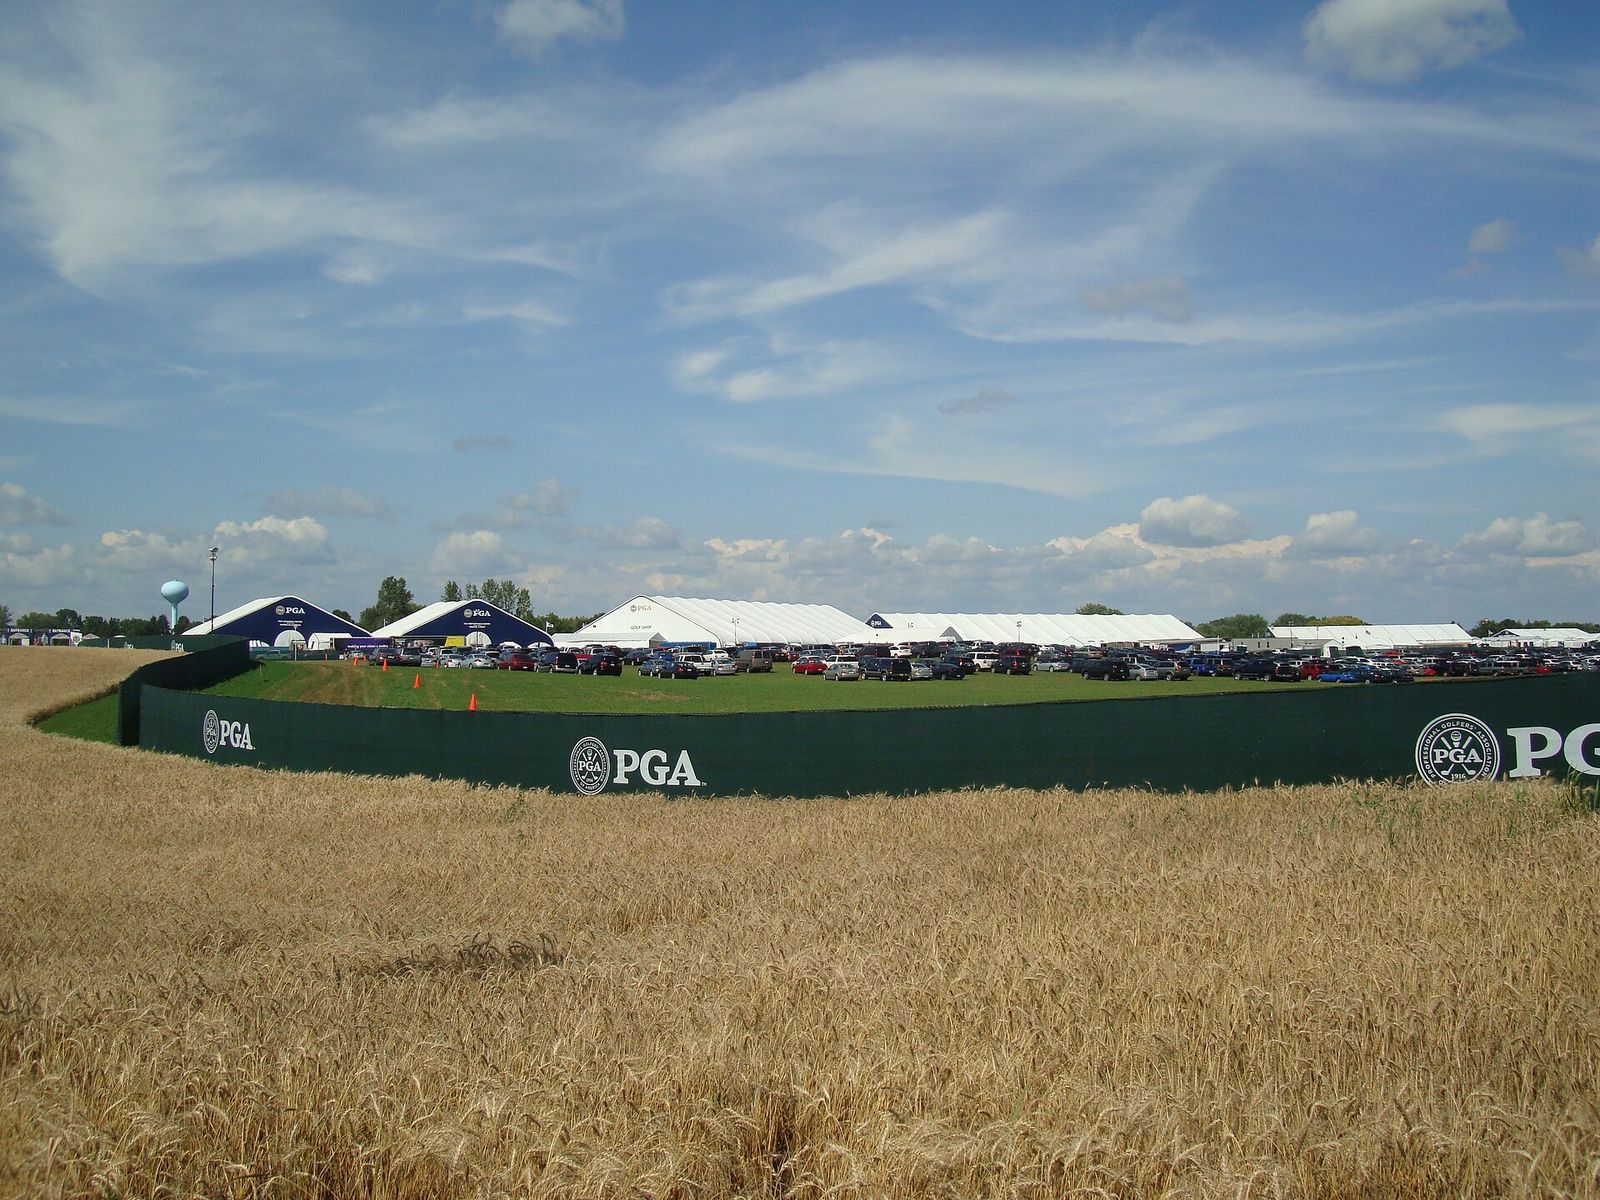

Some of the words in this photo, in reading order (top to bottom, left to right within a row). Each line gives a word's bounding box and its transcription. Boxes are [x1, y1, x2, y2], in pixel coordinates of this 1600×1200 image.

[219, 720, 253, 750] PGA
[578, 760, 602, 772] PGA
[613, 749, 701, 786] PGA
[1422, 728, 1441, 778] PROFESSIONAL
[1476, 731, 1493, 777] ASSOCIATION
[1433, 748, 1483, 763] PGA
